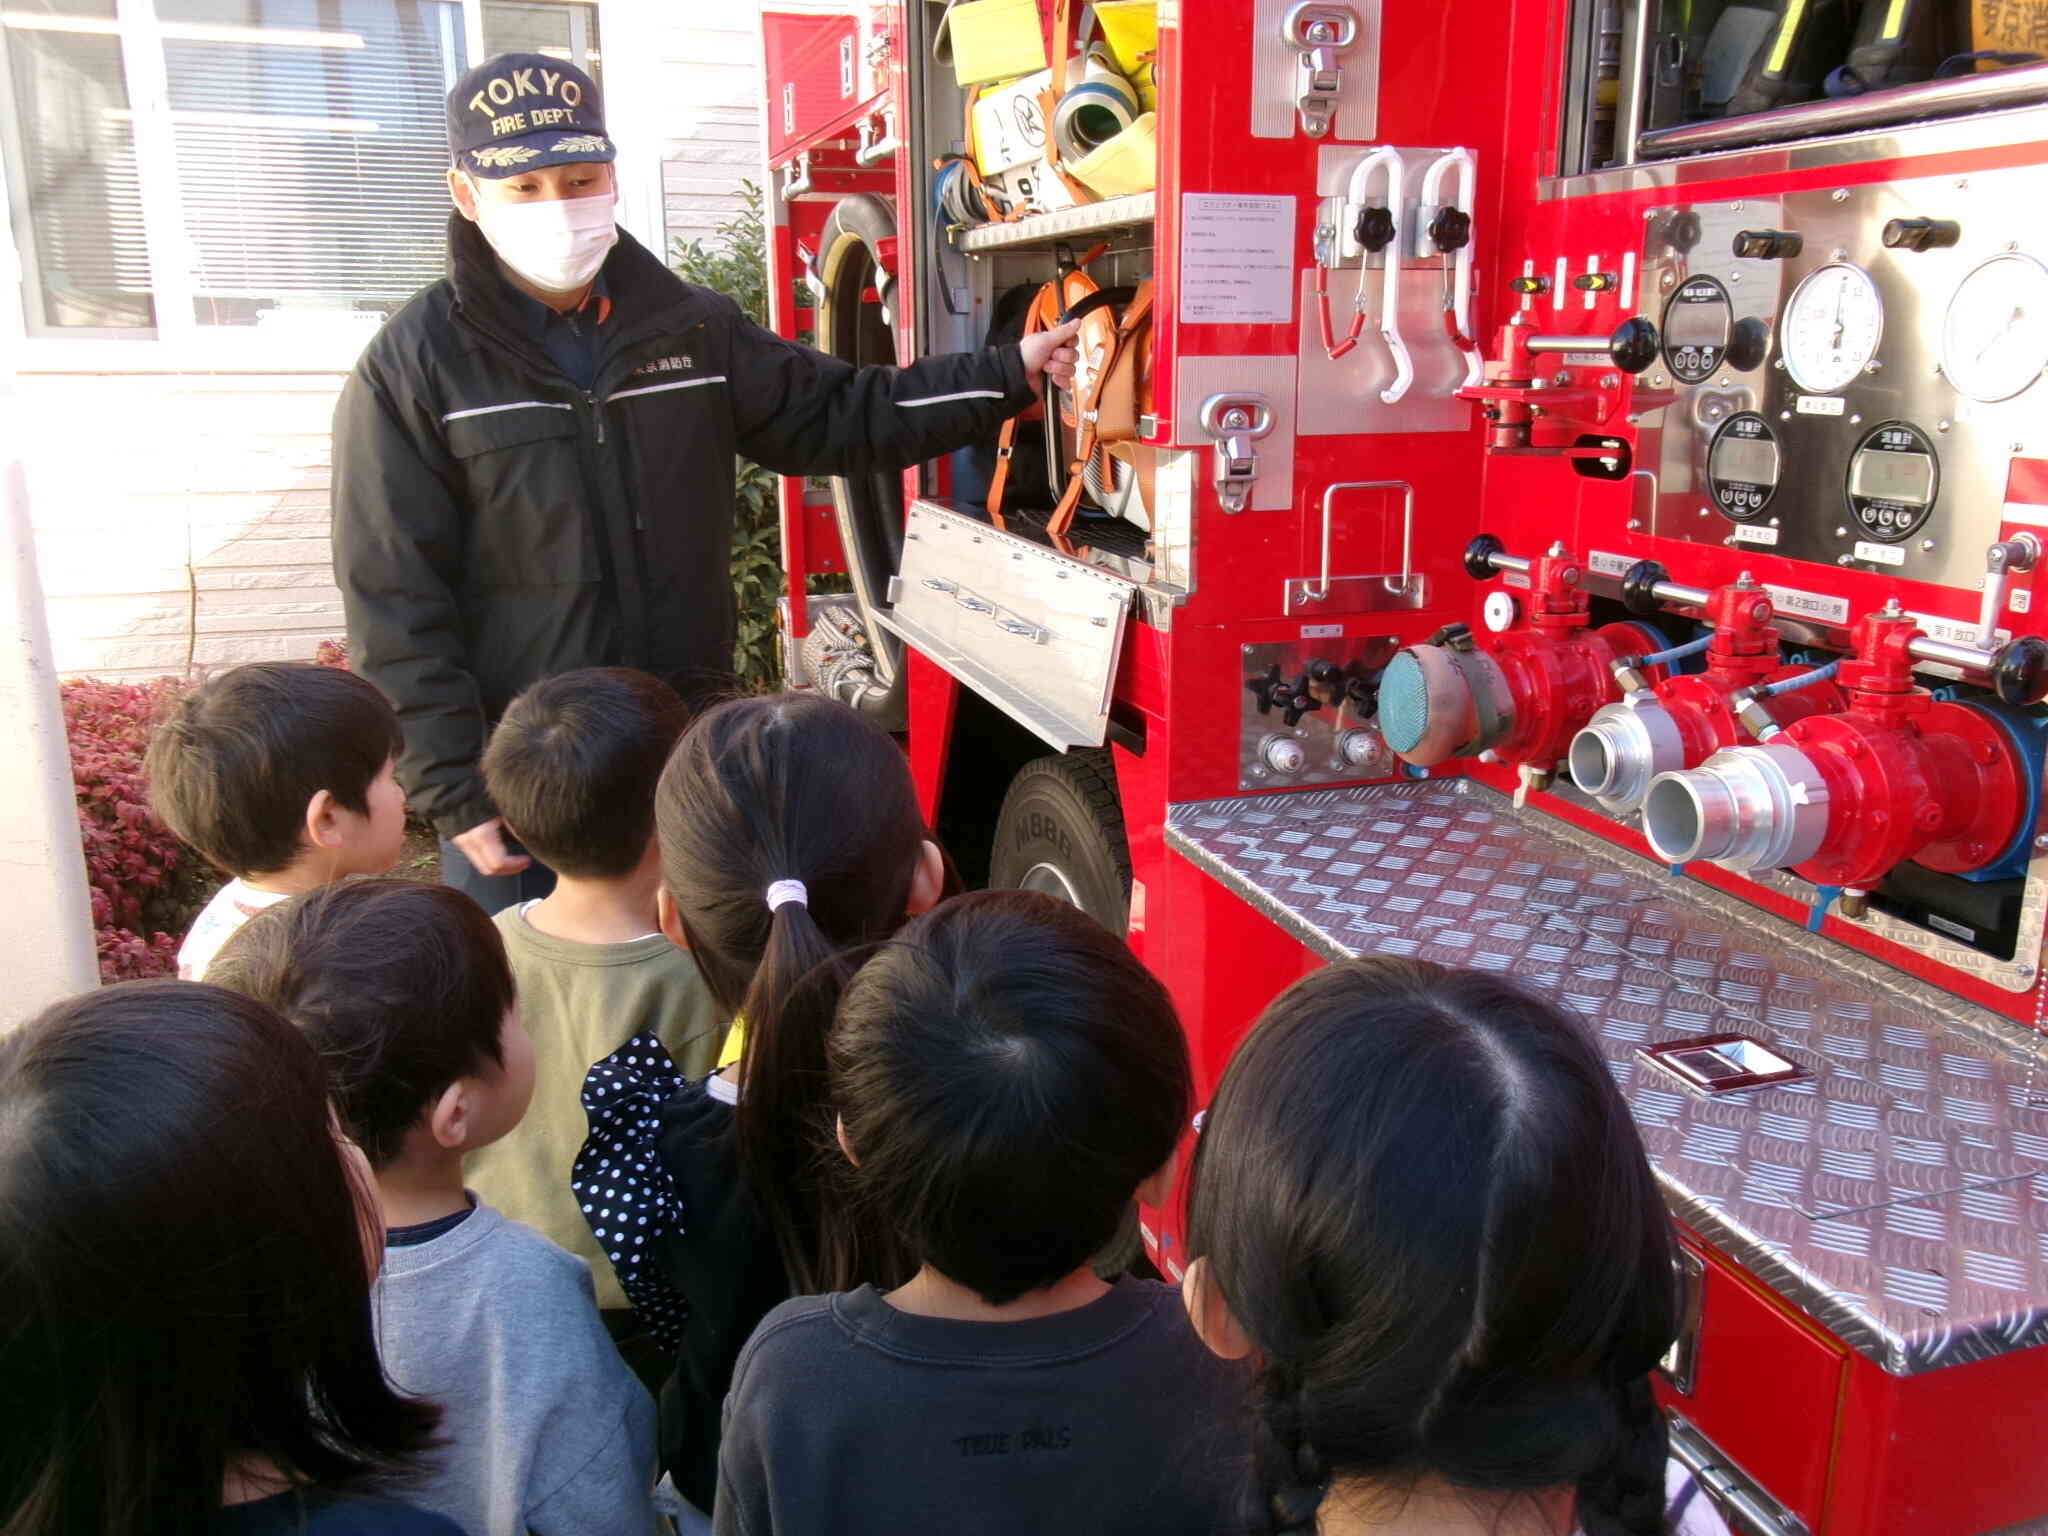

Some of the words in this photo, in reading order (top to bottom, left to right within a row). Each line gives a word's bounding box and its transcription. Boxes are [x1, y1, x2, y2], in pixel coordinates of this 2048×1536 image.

[469, 67, 582, 118] TOKYO
[491, 112, 527, 137] FIRE
[530, 108, 582, 127] DEPT.
